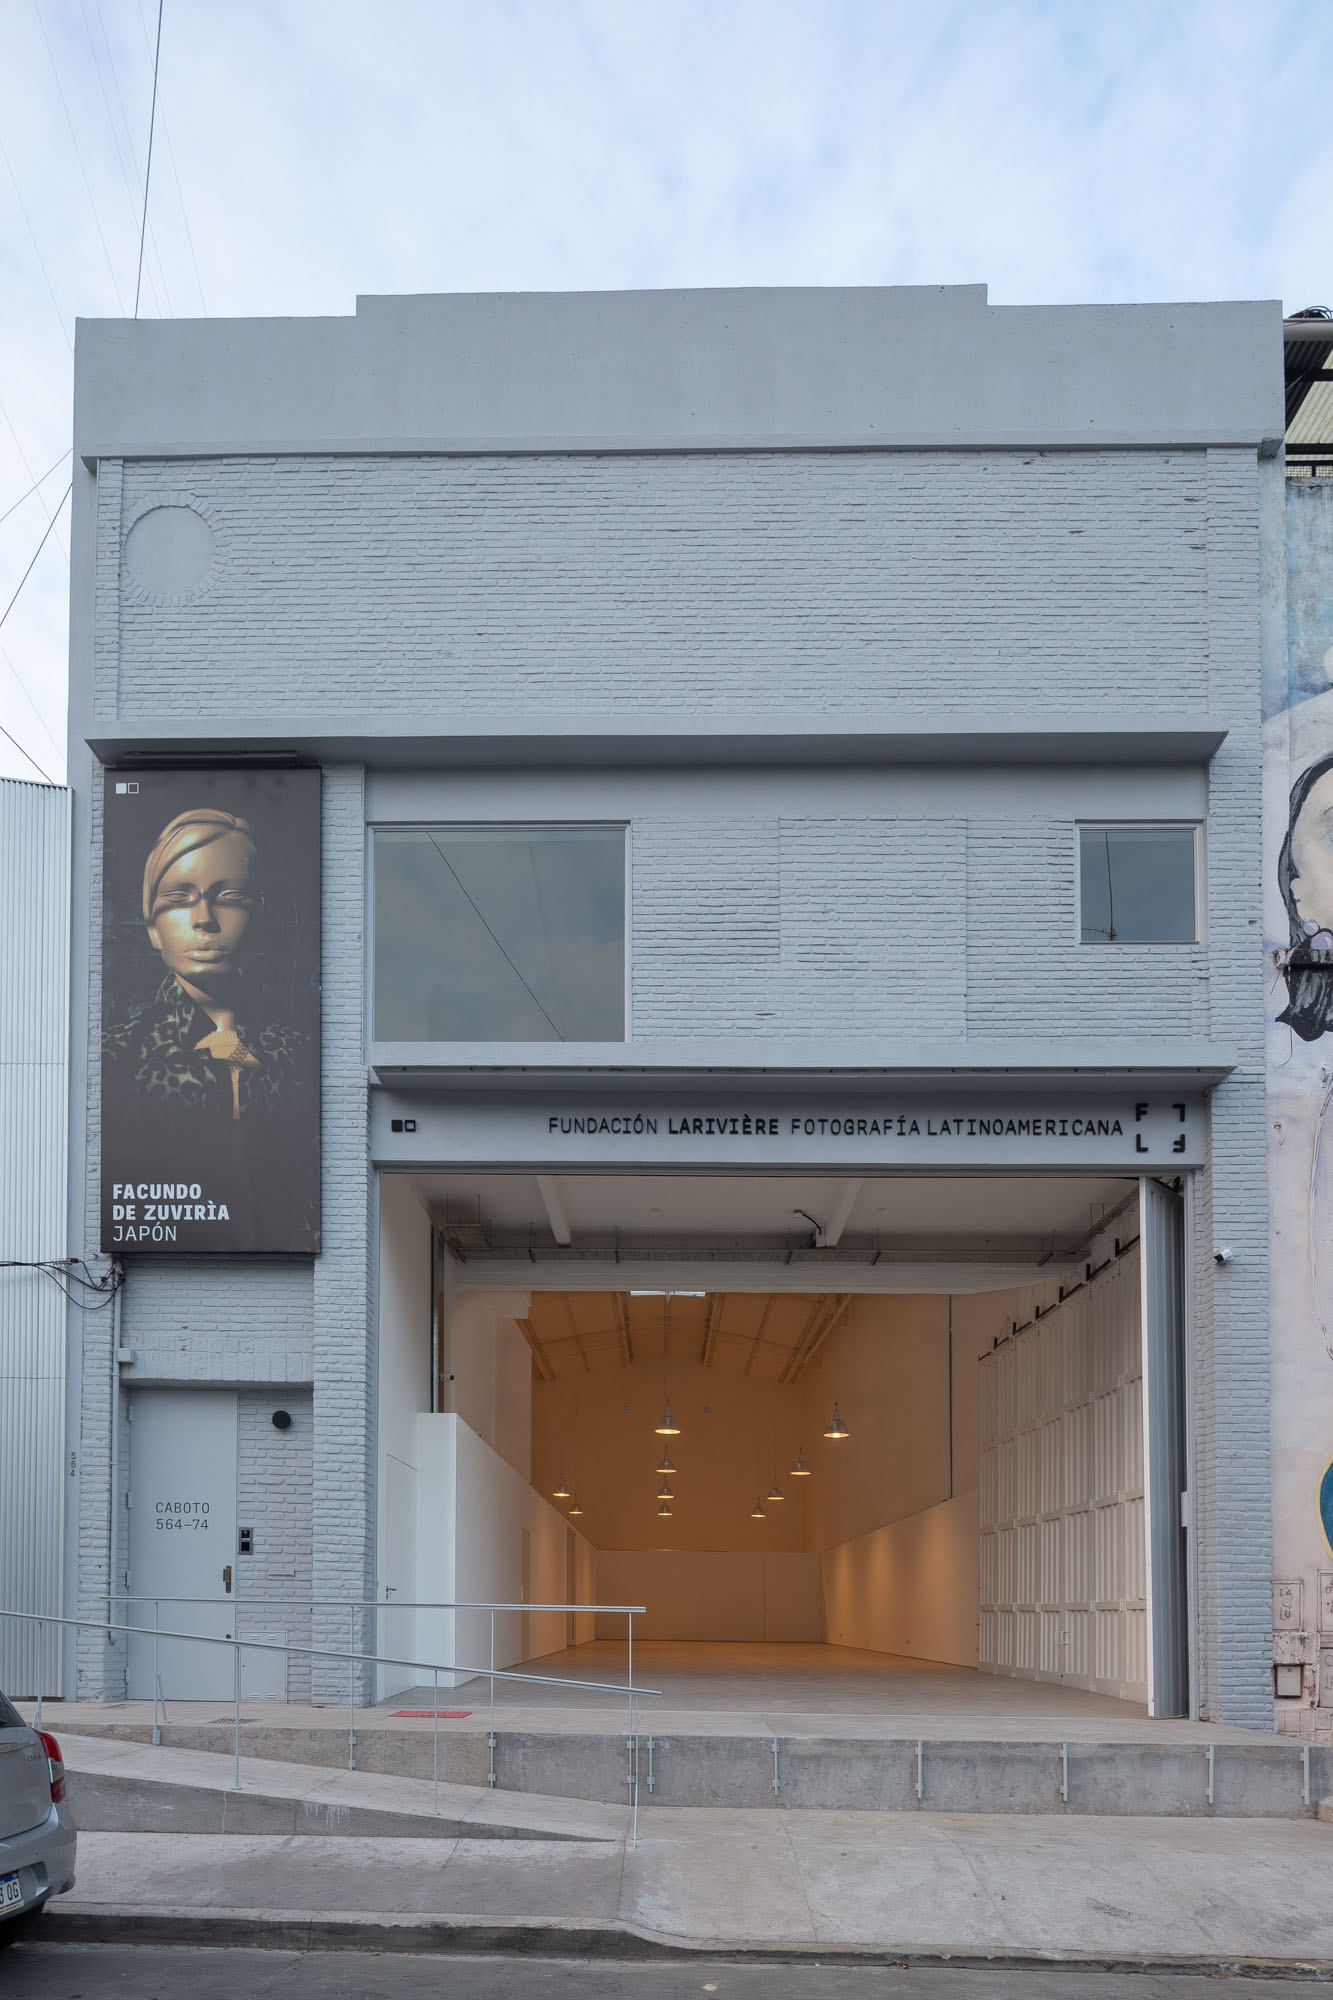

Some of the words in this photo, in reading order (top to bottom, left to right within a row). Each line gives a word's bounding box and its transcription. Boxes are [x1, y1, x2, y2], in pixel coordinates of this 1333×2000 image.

[549, 1114, 658, 1134] FUNDACIÓN
[668, 1113, 779, 1136] LARIVIÈRE
[791, 1115, 920, 1136] FOTOGRAFÍA
[927, 1119, 1123, 1136] LATINOAMERICANA
[112, 1183, 202, 1200] FACUNDO
[112, 1204, 136, 1221] DE
[144, 1200, 230, 1221] ZUVIRÌA
[112, 1221, 177, 1242] JAPÓN
[155, 1501, 210, 1514] CABOTO
